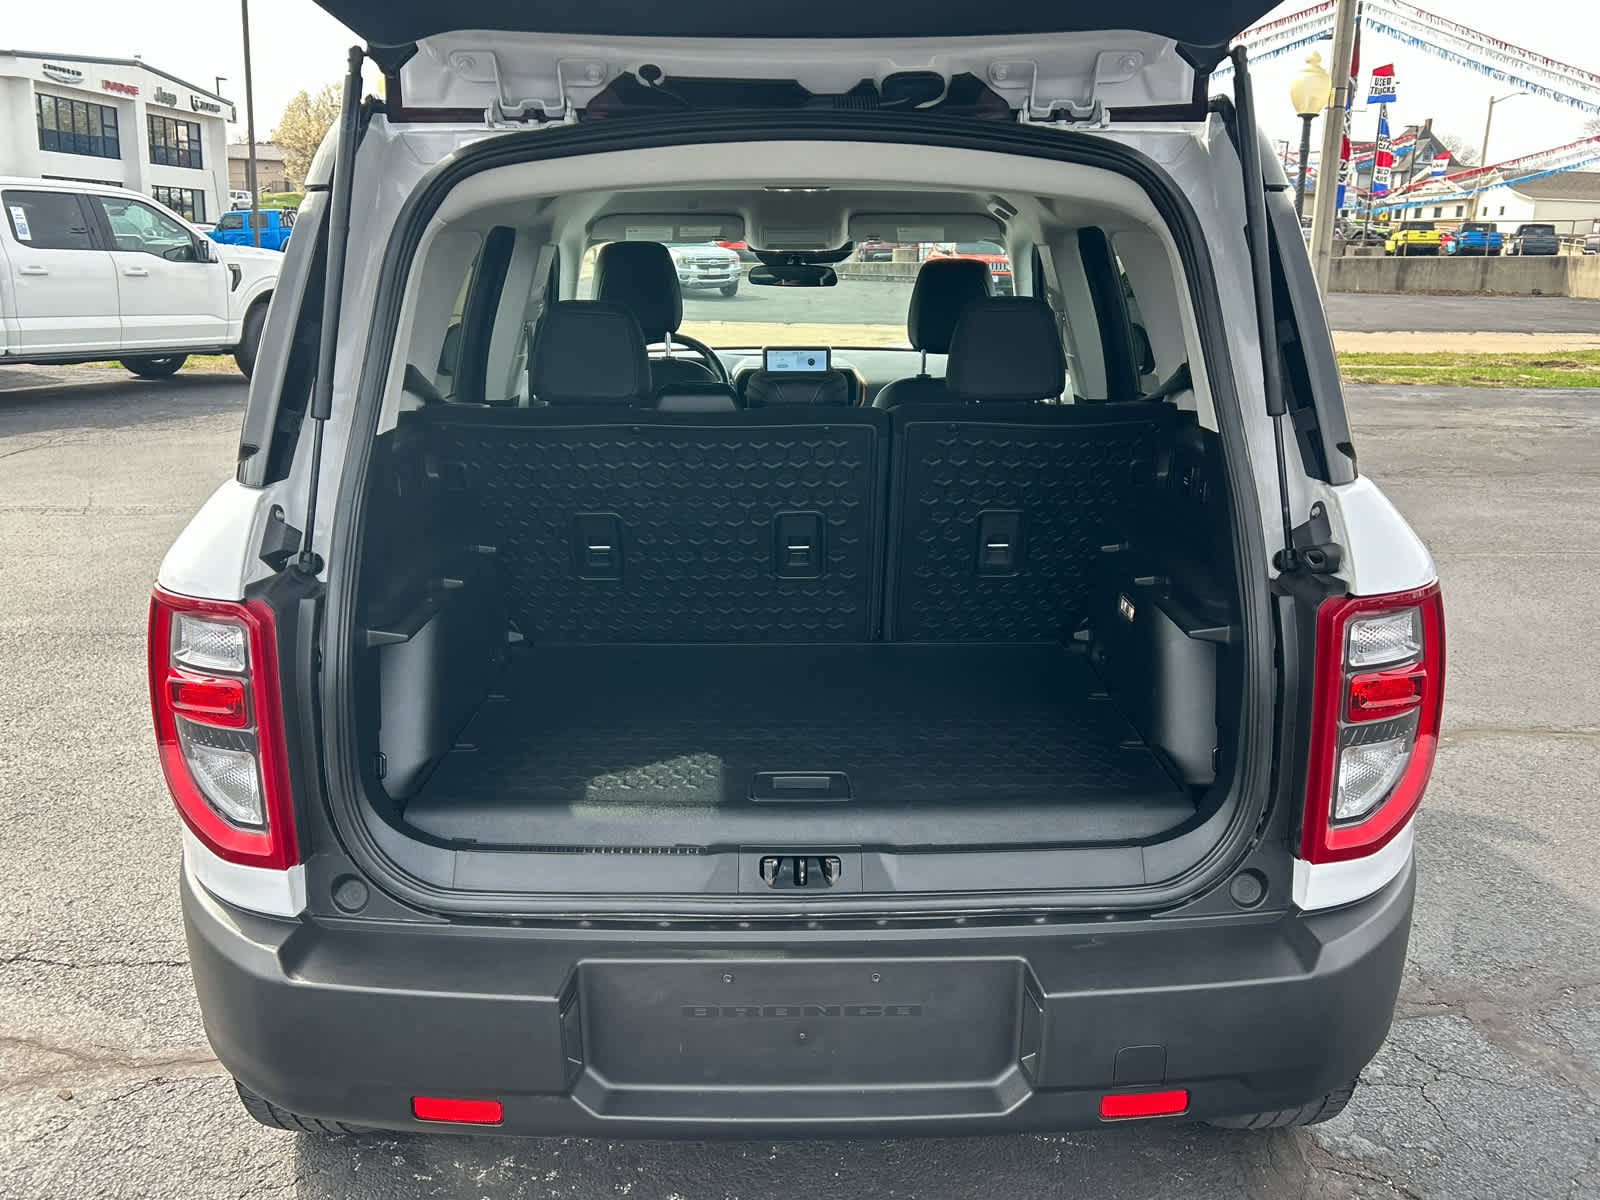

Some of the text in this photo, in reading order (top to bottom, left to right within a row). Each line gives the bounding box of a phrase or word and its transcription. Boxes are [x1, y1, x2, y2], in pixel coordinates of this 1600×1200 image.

[1374, 77, 1392, 87] USED
[1370, 86, 1396, 95] TRUCKS
[681, 1004, 923, 1017] BRONCO
